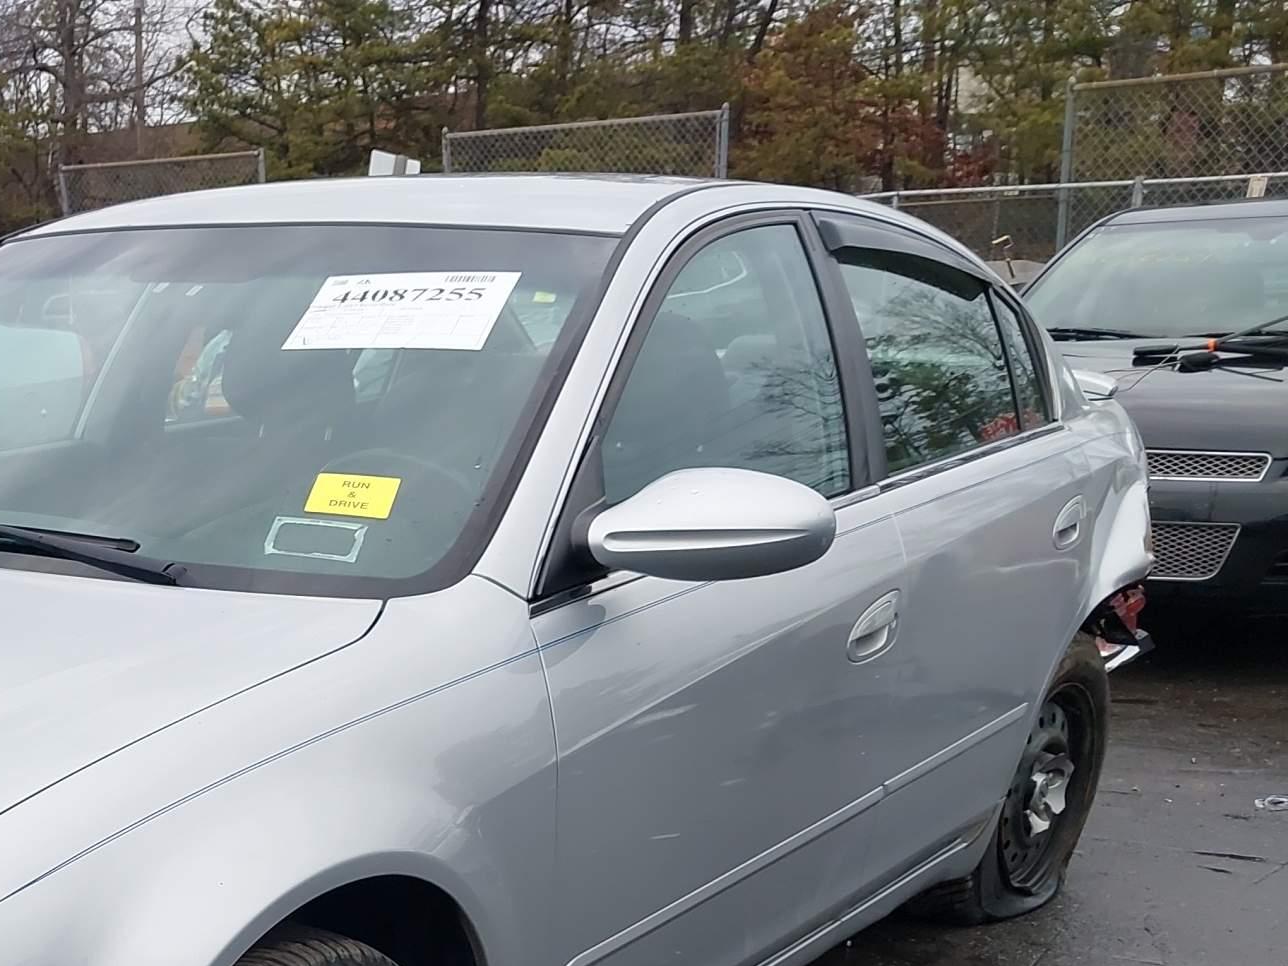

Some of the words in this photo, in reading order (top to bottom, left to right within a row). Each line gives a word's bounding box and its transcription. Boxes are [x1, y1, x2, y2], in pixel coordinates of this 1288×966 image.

[332, 287, 486, 304] 44087255
[342, 480, 370, 489] RUN
[329, 499, 368, 510] DRIVE
